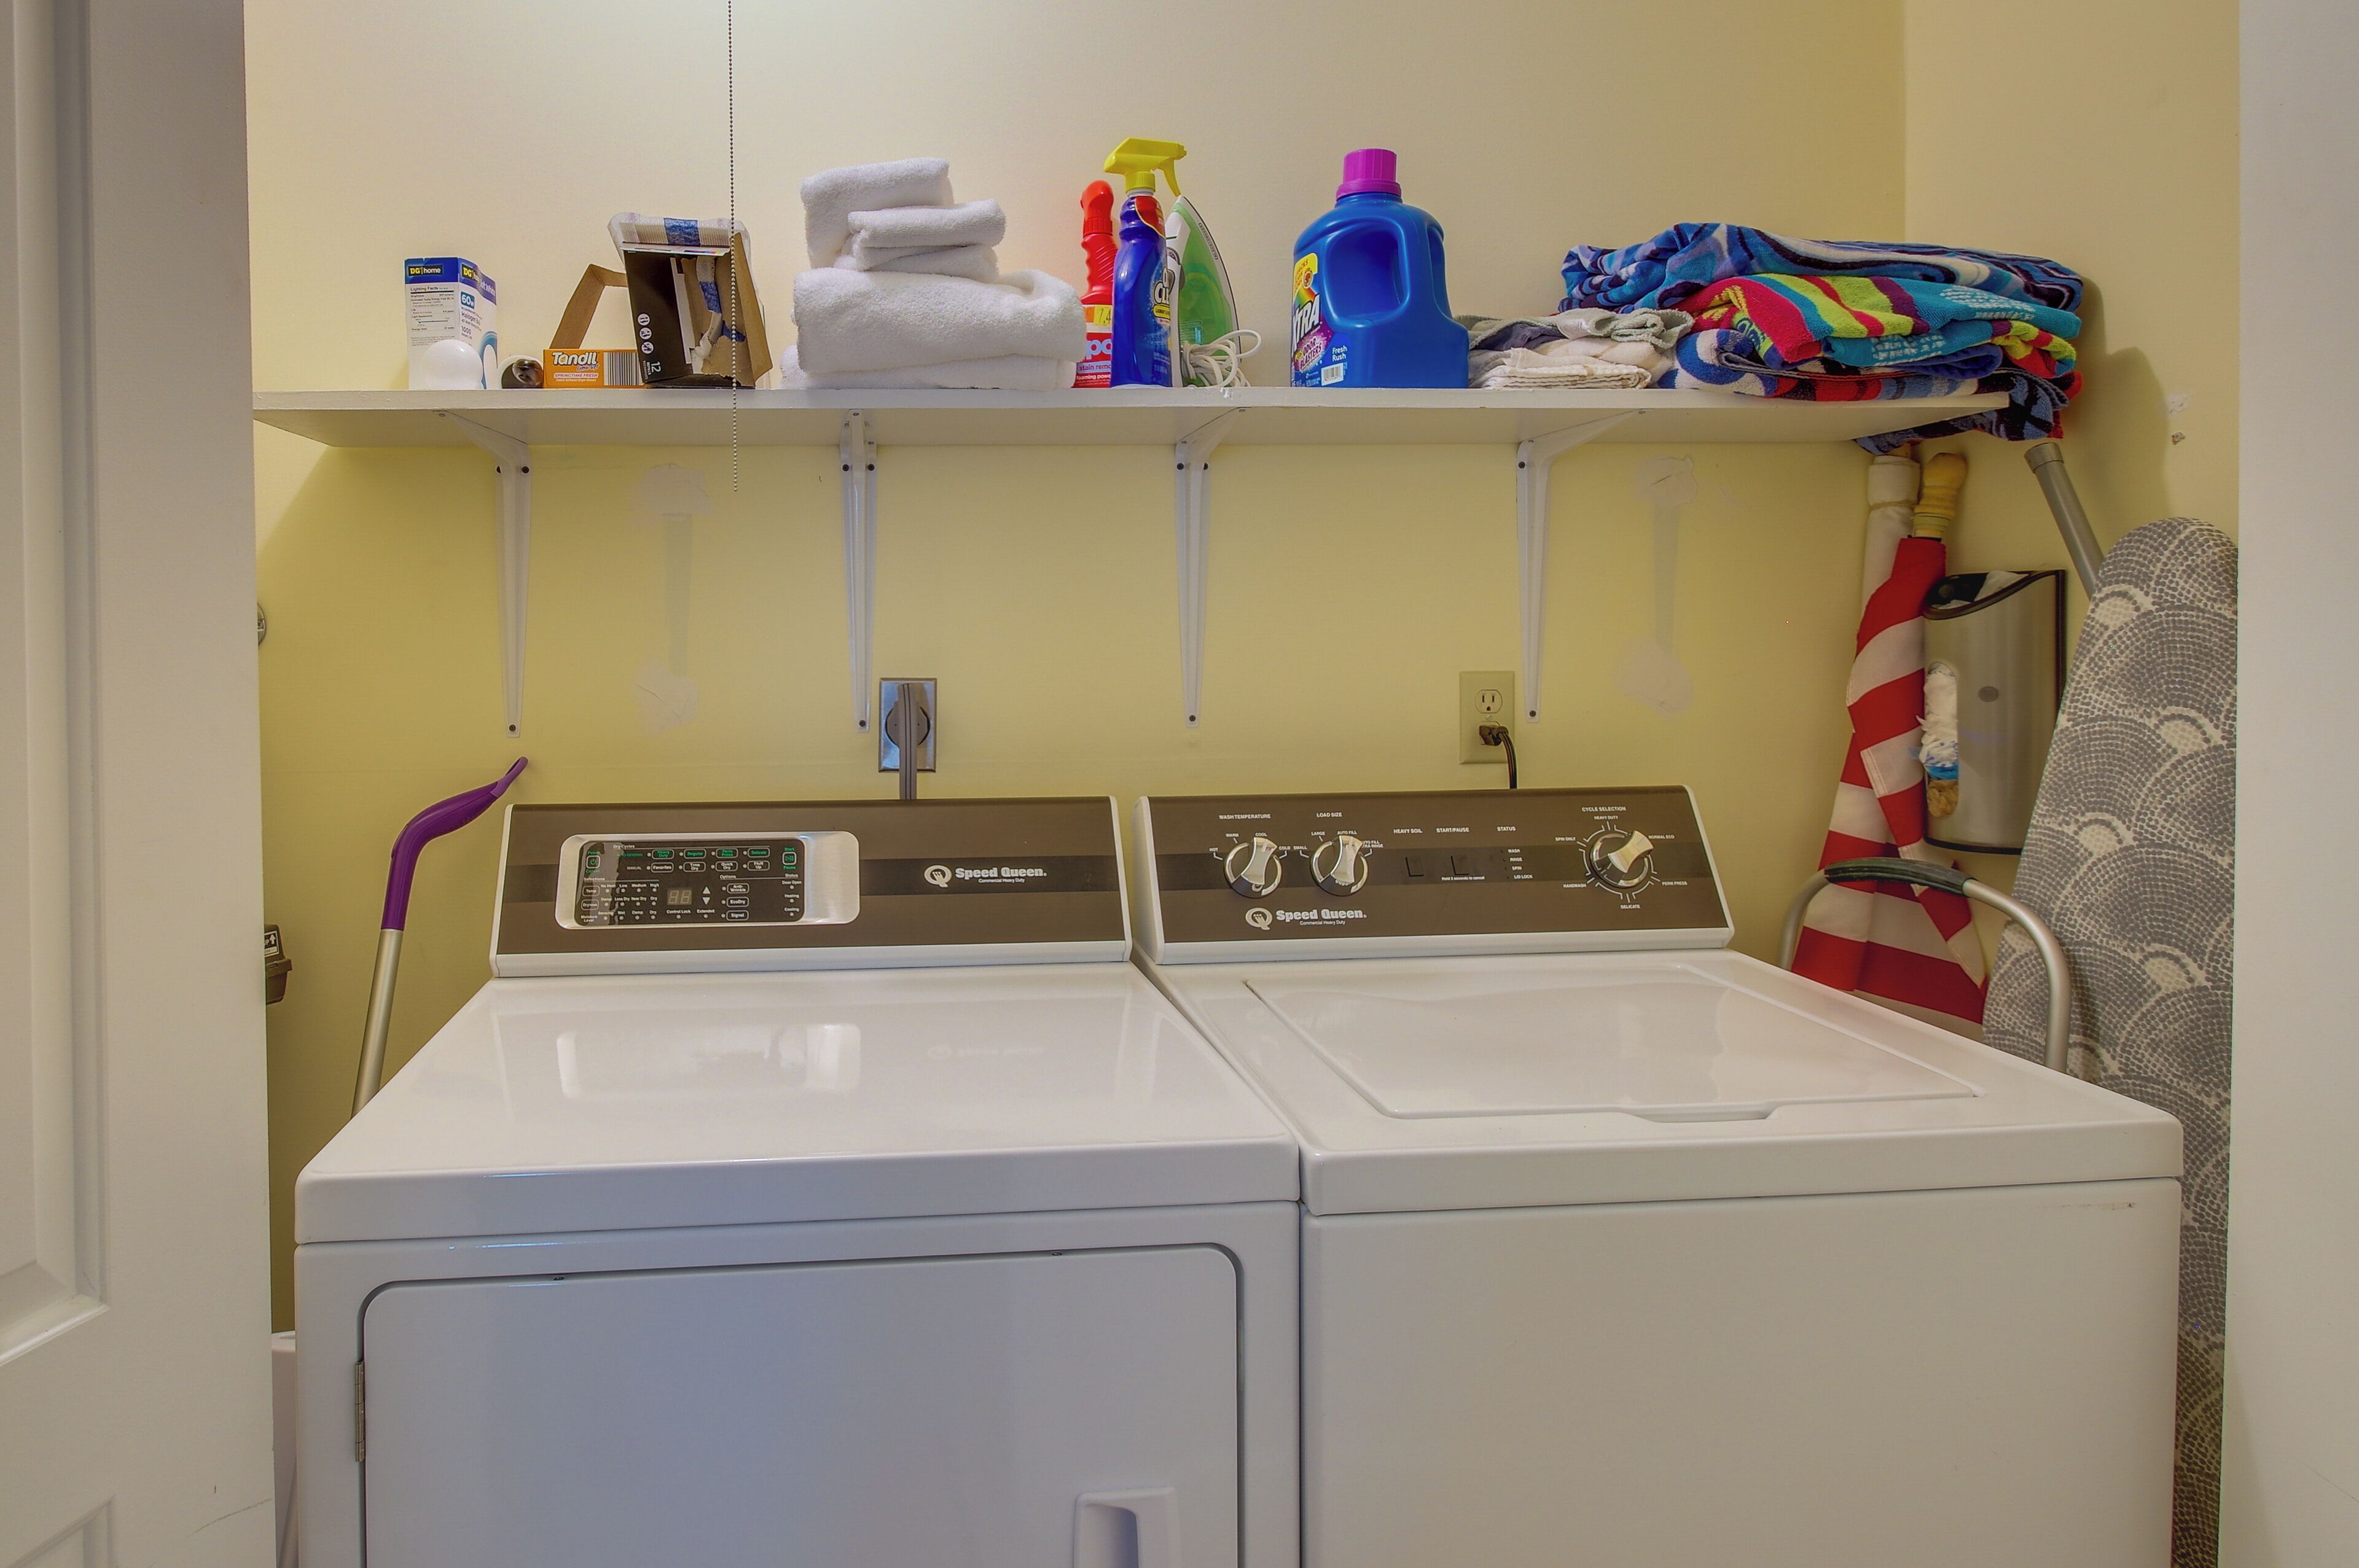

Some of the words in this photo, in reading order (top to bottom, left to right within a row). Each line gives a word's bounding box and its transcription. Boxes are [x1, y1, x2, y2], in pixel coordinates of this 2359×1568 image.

[1332, 345, 1347, 354] Fresh
[552, 352, 597, 365] Tandil
[1332, 353, 1346, 362] Rush
[651, 361, 662, 373] 12
[955, 868, 998, 880] Speed
[1276, 909, 1318, 922] Speed
